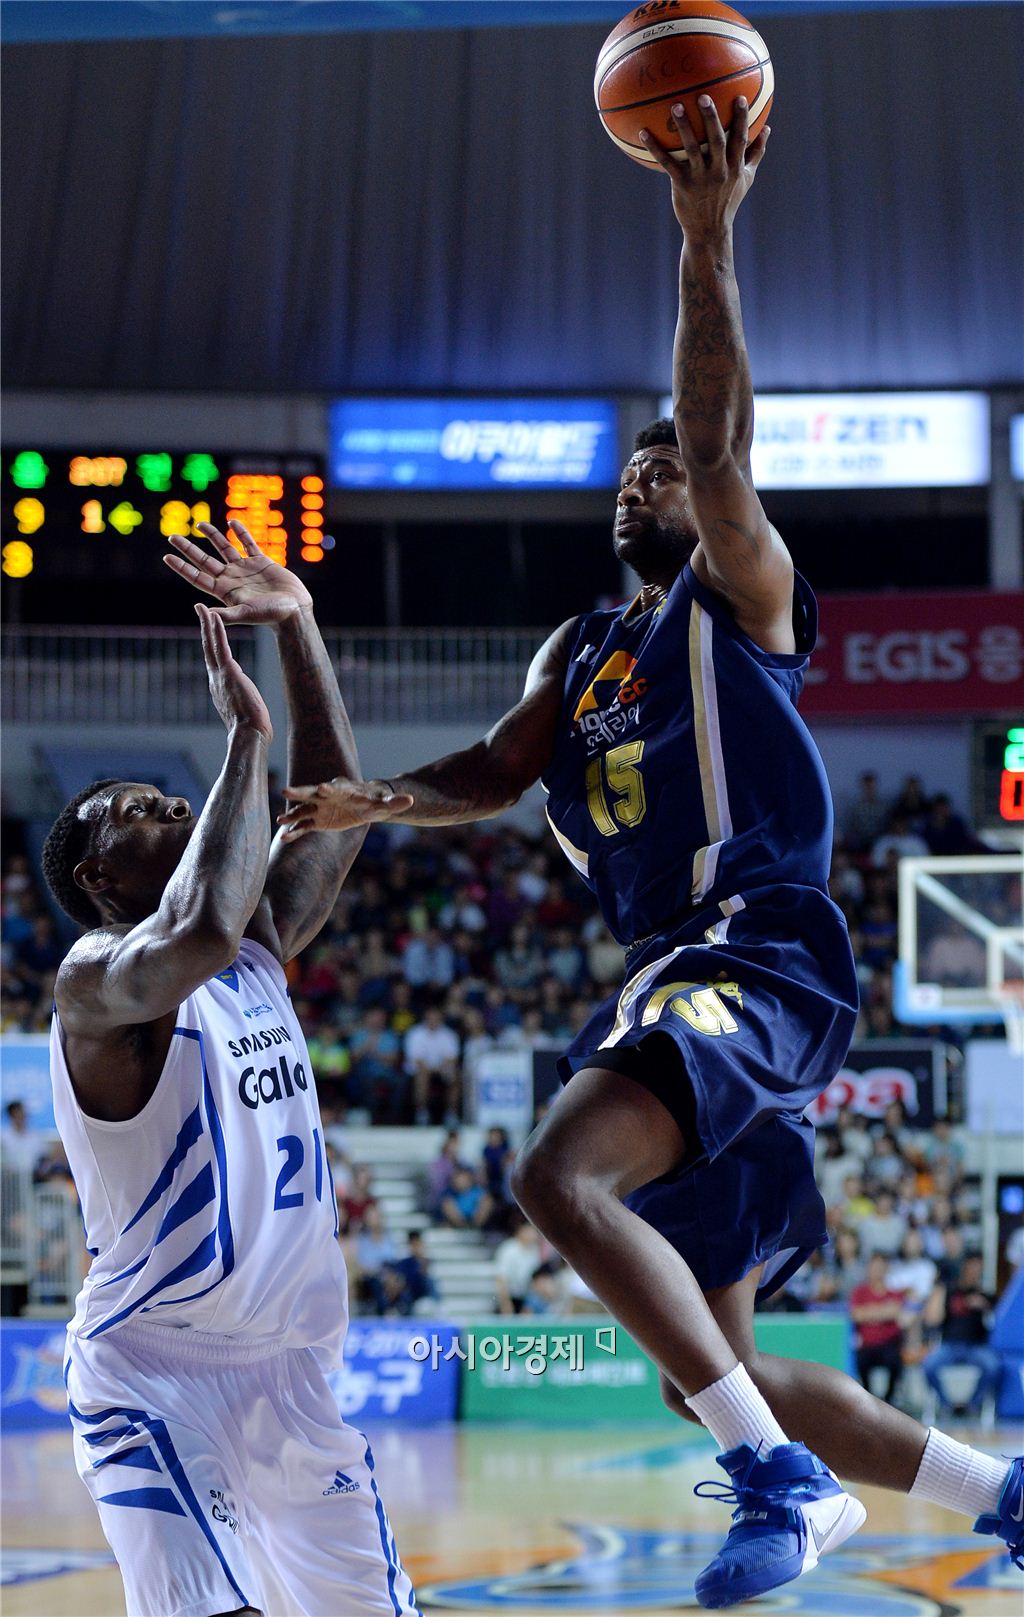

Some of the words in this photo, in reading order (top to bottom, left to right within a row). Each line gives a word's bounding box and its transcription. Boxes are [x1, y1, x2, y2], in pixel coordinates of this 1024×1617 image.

[845, 630, 969, 683] EGIS
[585, 739, 648, 838] 15
[274, 1128, 322, 1211] 21
[322, 1481, 361, 1496] adidas
